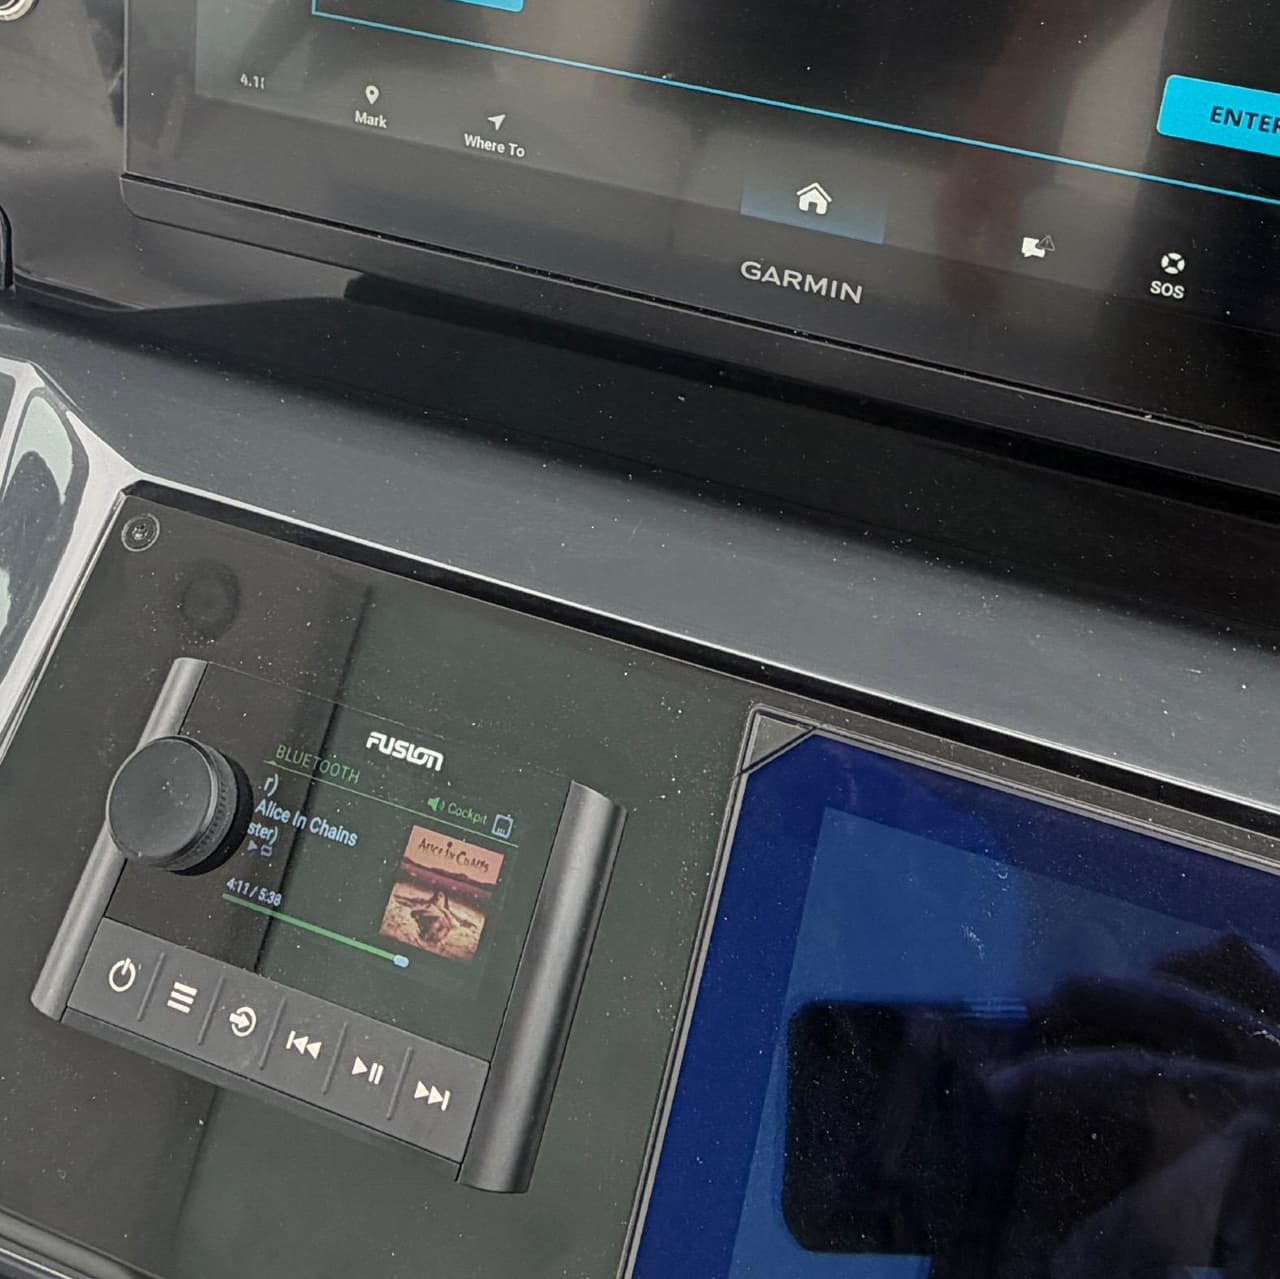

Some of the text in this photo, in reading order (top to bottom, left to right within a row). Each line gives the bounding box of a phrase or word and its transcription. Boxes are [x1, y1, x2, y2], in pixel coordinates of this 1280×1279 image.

[354, 110, 388, 129] Mark
[464, 132, 525, 158] Where To
[739, 260, 864, 305] GARMIN
[1149, 280, 1186, 300] SOS
[274, 743, 362, 785] BLUETOOTH
[254, 798, 359, 848] Alice In Chains
[447, 800, 488, 827] Cockpit
[225, 876, 250, 898] 4:11
